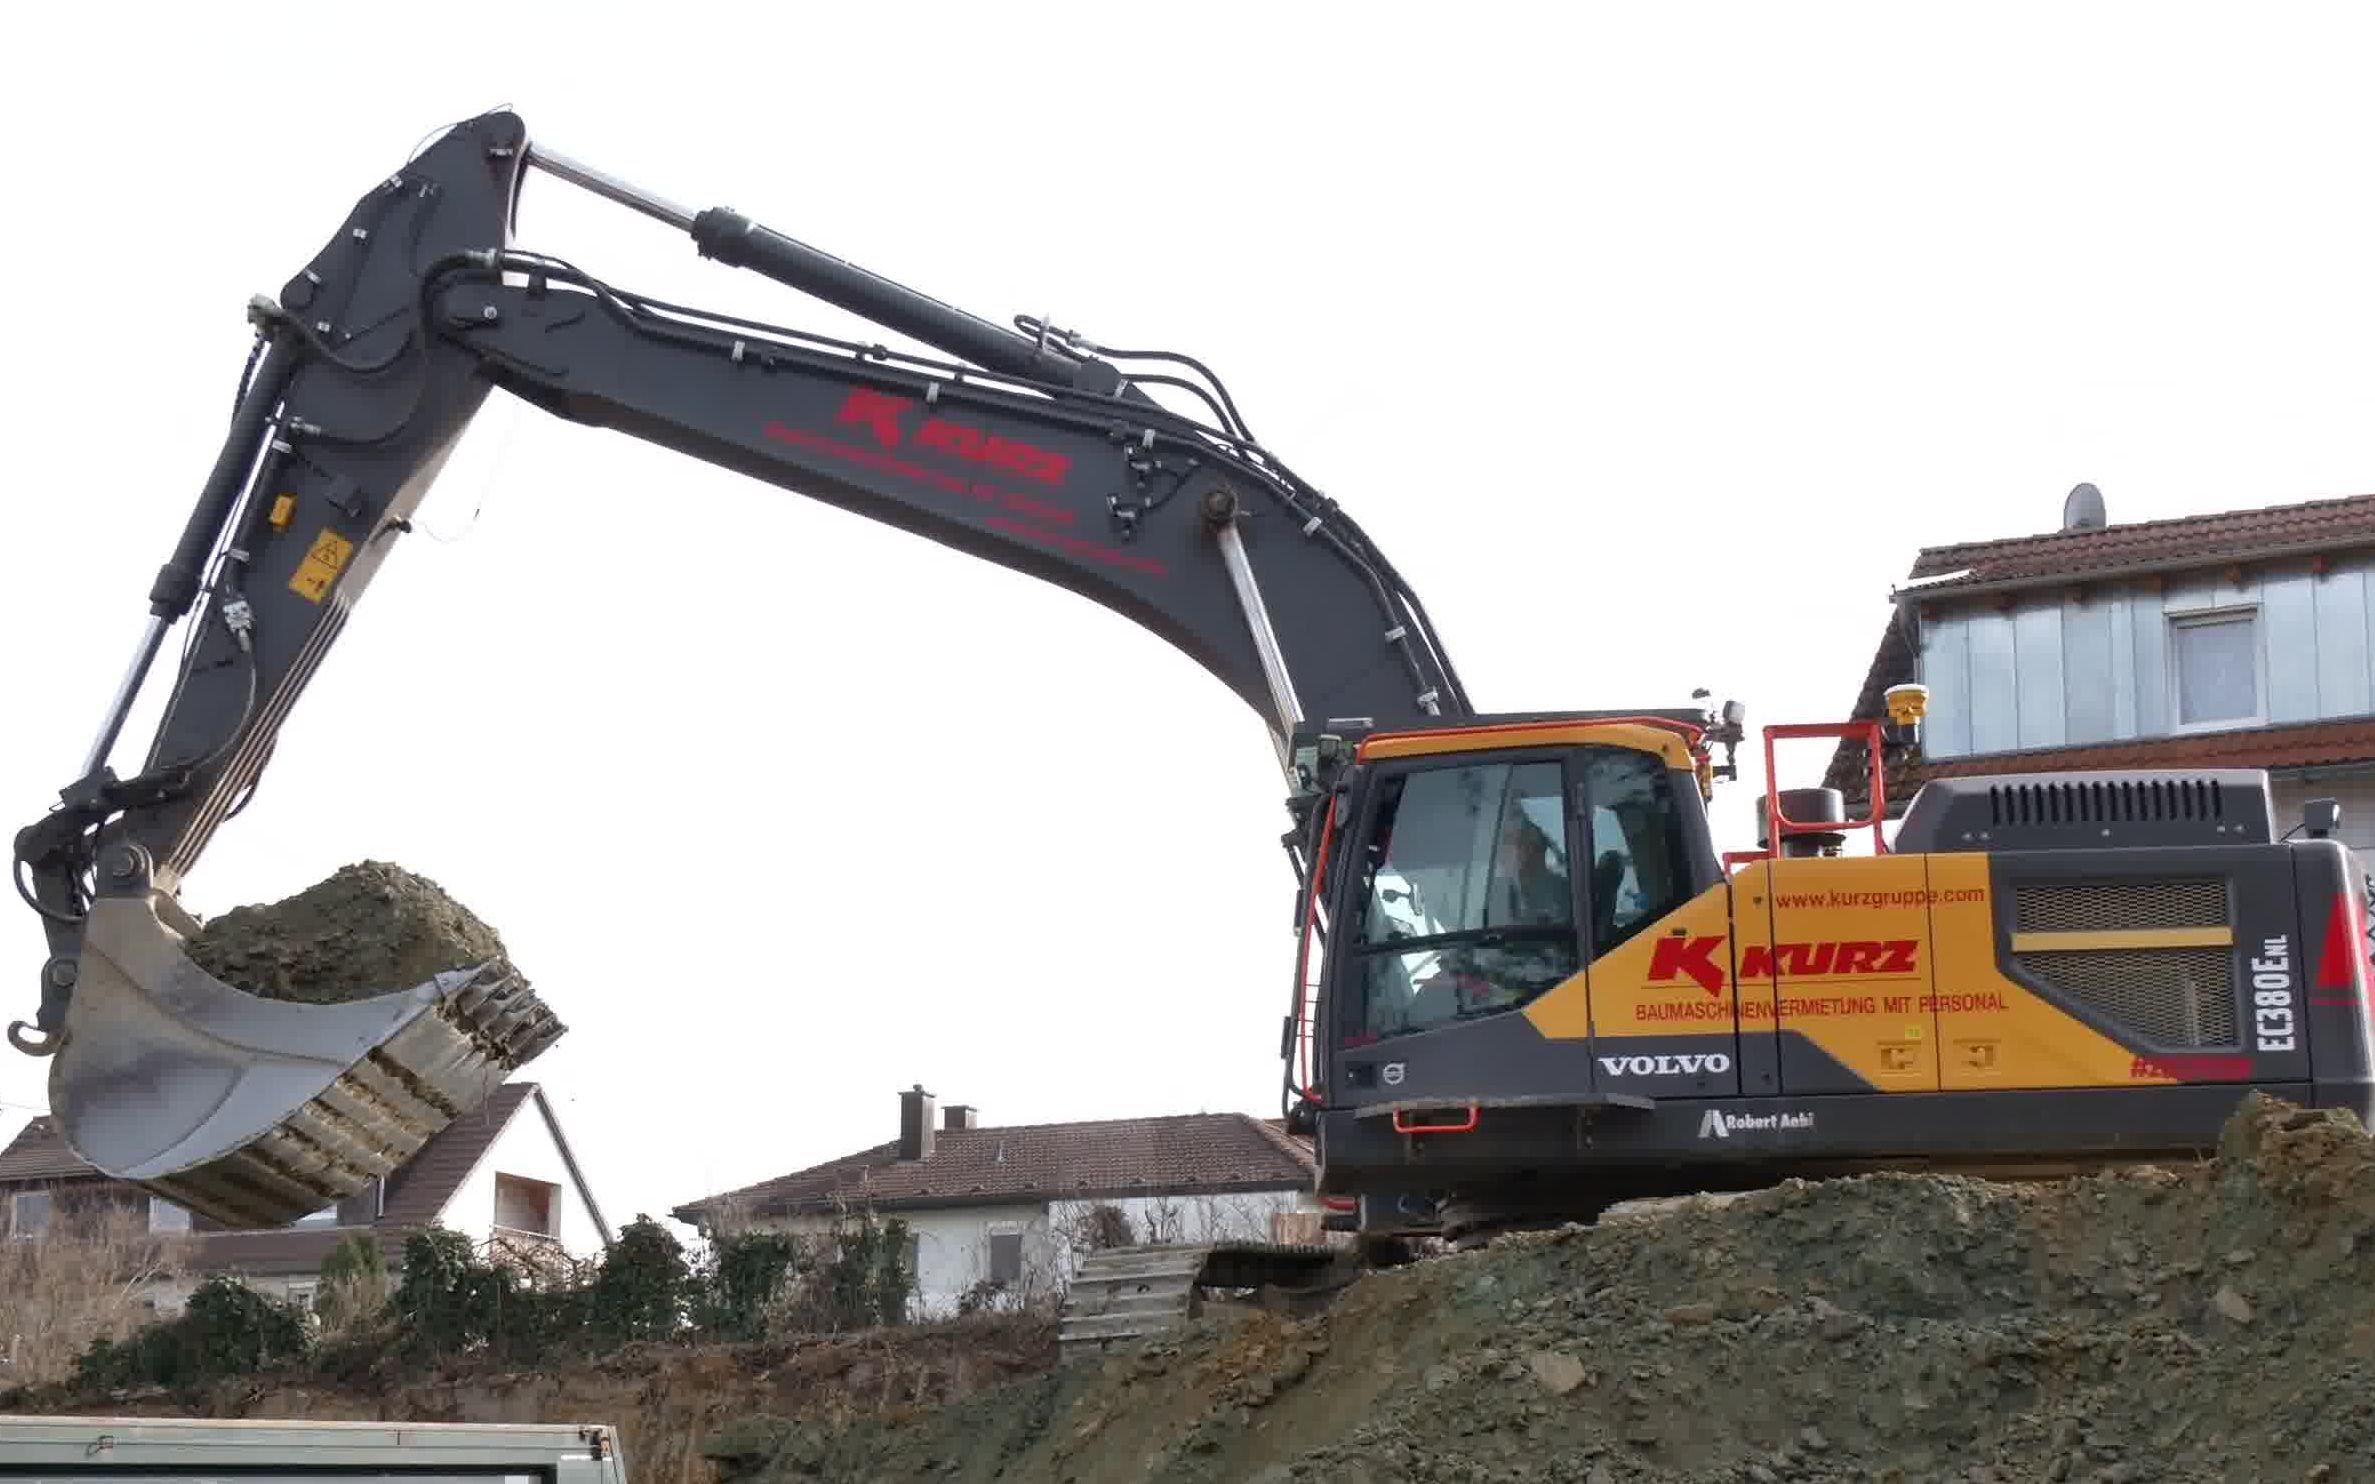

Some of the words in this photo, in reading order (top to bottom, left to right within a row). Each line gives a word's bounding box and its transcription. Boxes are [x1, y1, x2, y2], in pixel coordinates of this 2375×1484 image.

[1776, 888, 1985, 908] www.kurzgruppe.com
[1648, 935, 1727, 998] K
[1739, 940, 1919, 978] KURZ
[1884, 997, 1910, 1014] MIT
[1919, 992, 2009, 1013] PERSONAL
[1598, 1053, 1730, 1076] VOLVO
